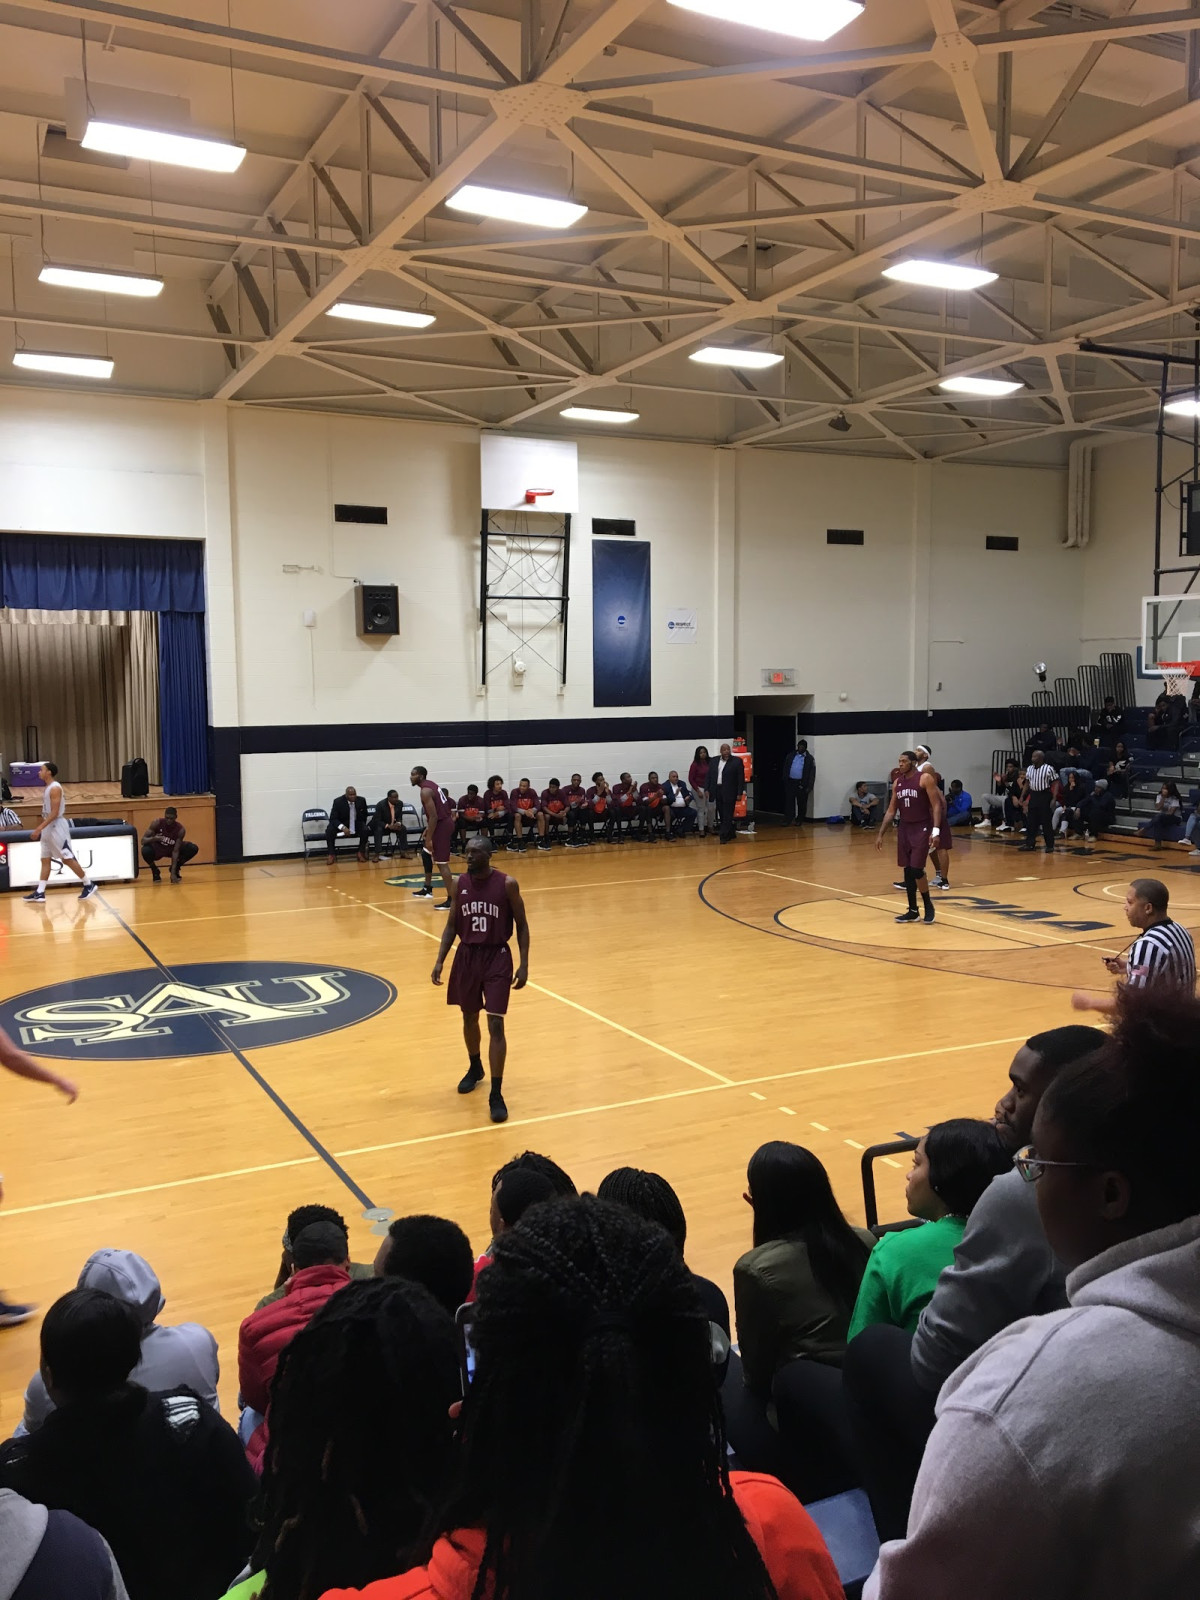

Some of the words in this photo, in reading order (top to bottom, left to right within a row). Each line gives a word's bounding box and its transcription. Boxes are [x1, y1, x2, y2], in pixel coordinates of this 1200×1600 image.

[461, 901, 499, 919] CLAFLIN
[471, 916, 487, 932] 20
[14, 971, 351, 1046] SAU
